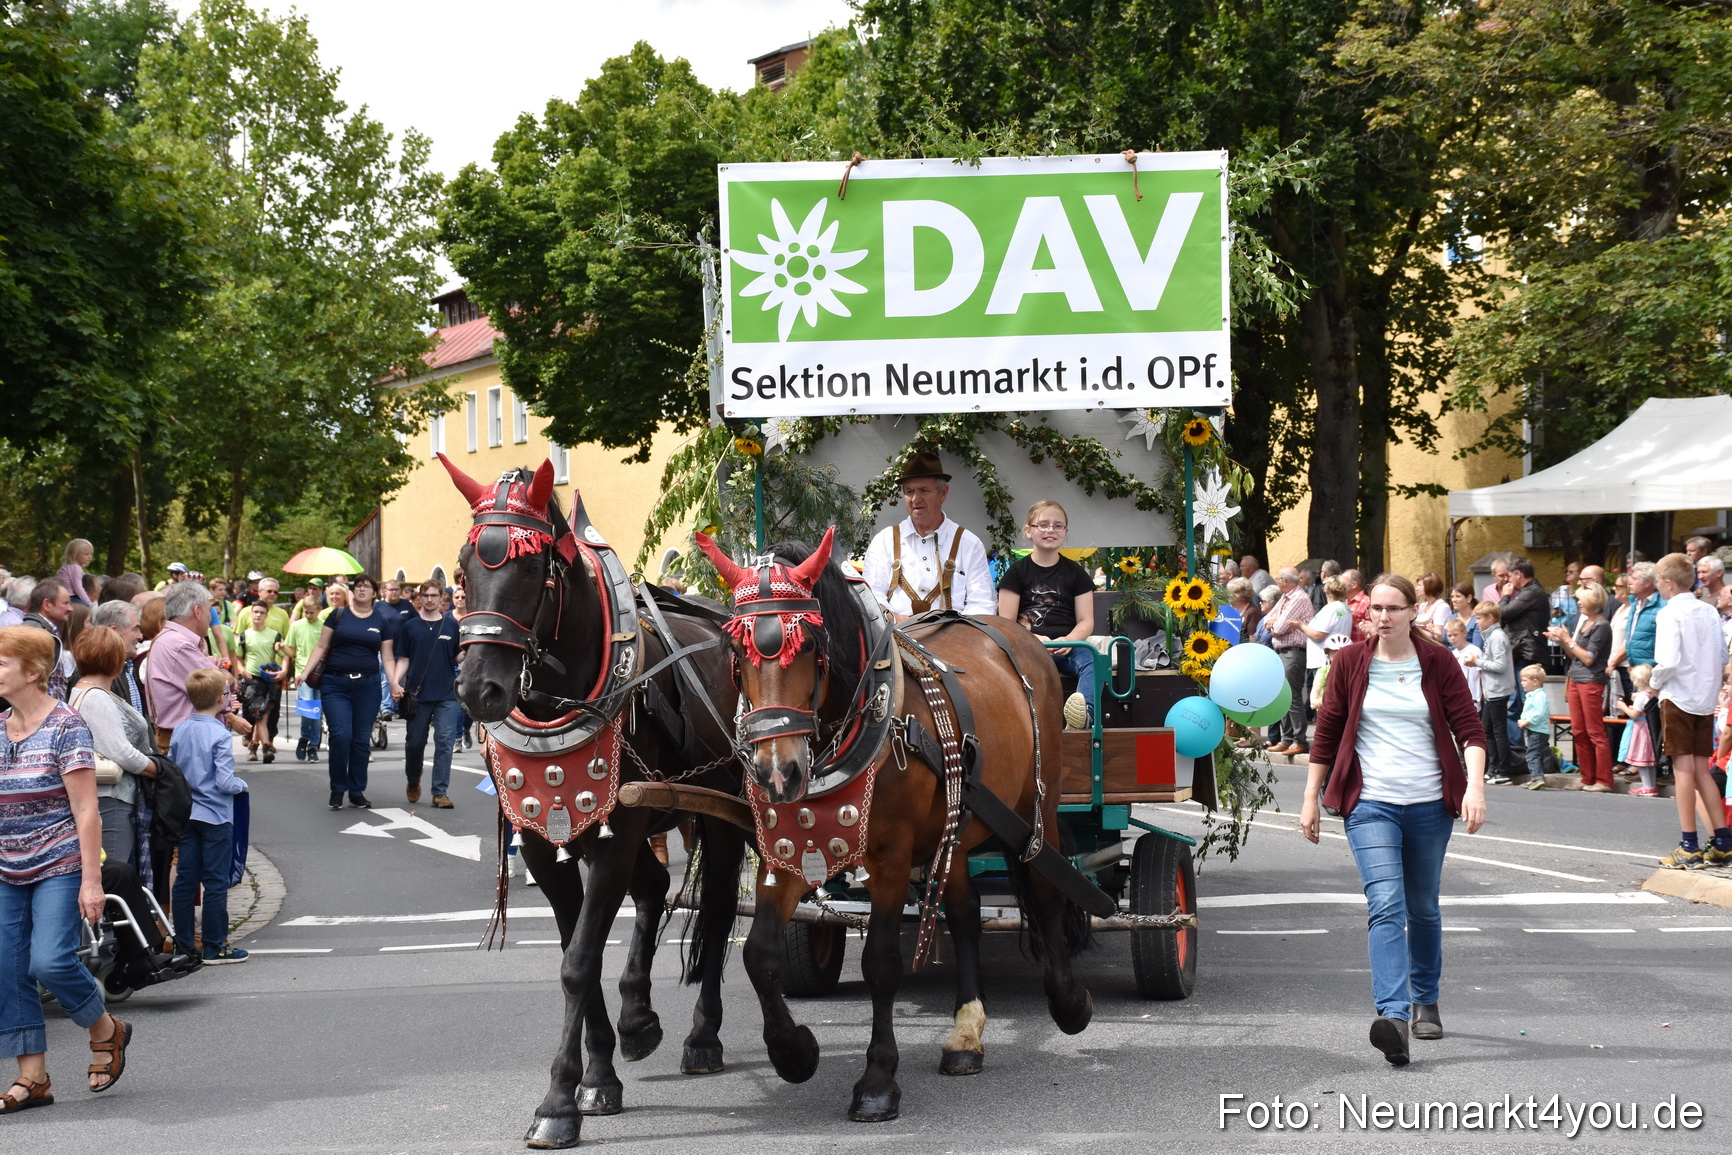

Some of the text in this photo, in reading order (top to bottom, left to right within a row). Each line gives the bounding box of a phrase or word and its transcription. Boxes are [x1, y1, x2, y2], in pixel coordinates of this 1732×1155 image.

[882, 192, 1204, 318] DAV
[731, 353, 1225, 401] Sektion Neumarkt i.d. OPf.
